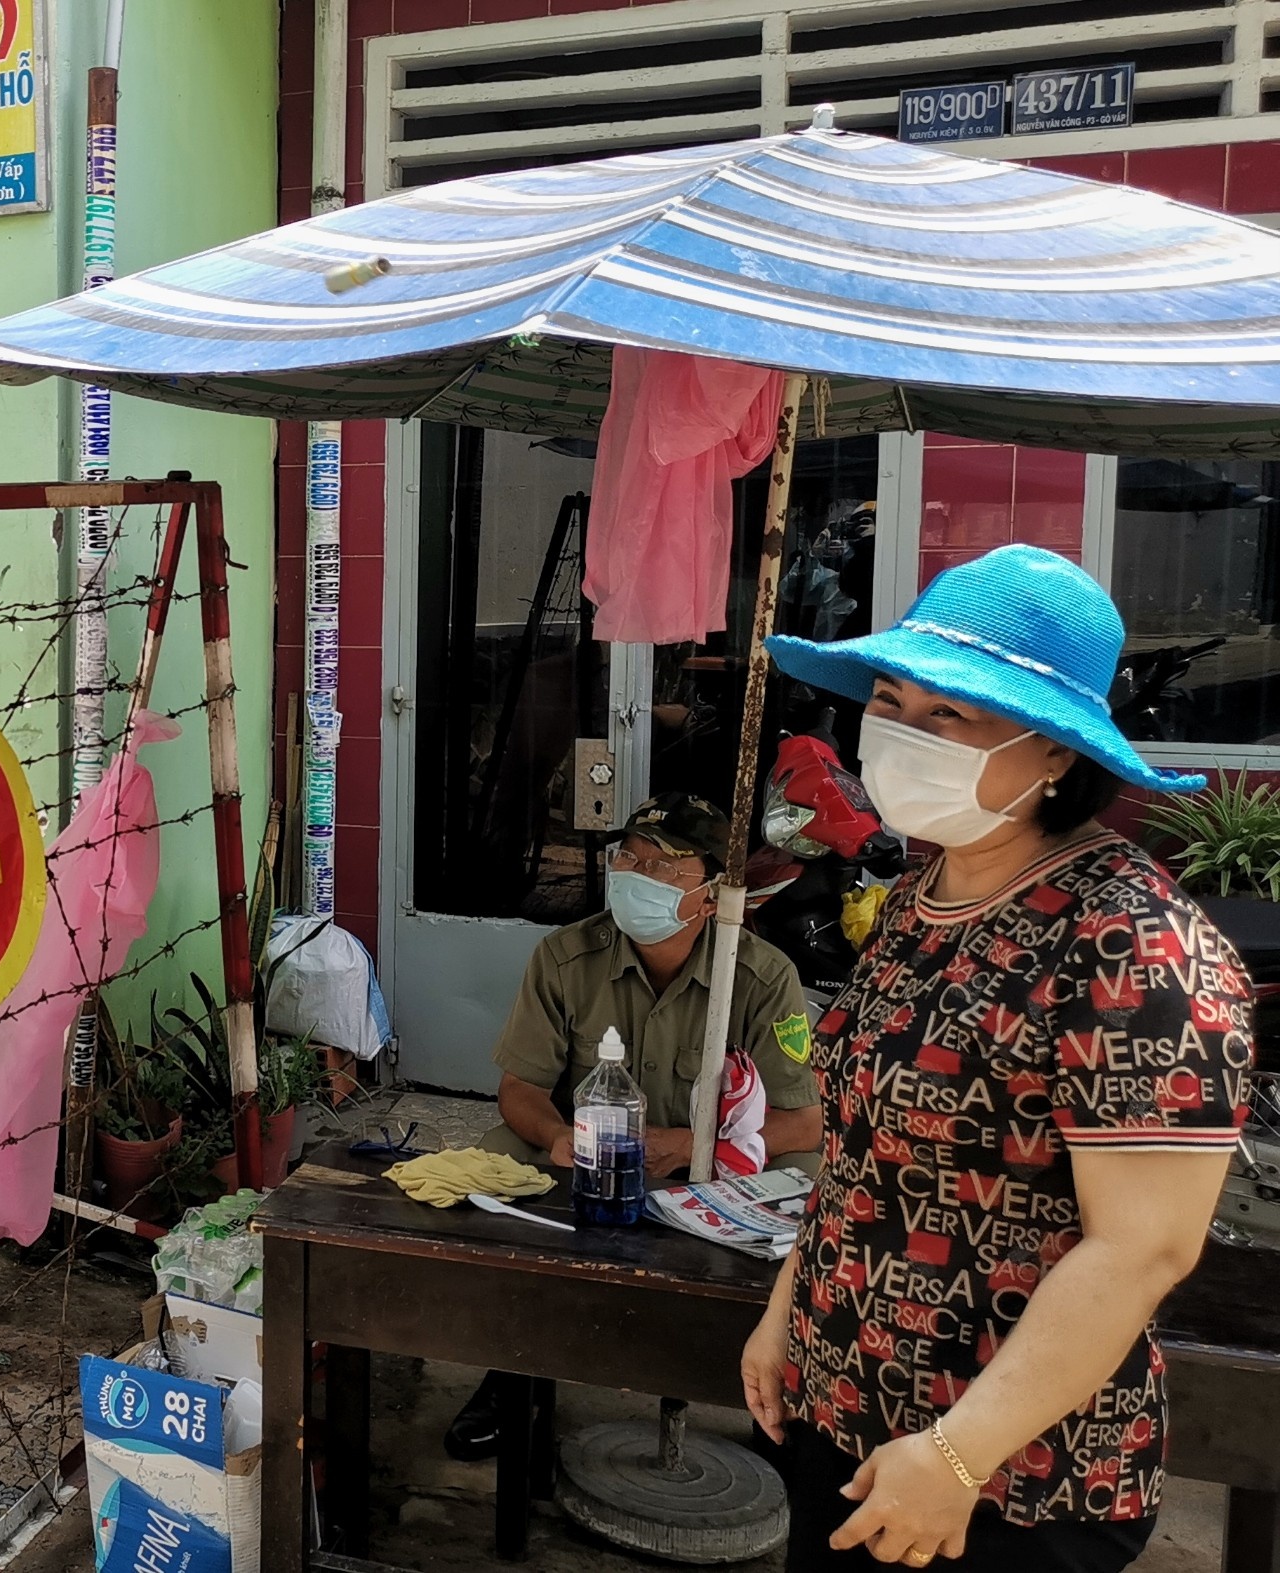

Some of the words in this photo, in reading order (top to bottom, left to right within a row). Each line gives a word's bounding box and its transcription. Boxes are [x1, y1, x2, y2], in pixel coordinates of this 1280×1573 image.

[1018, 70, 1127, 115] 437/11
[815, 979, 846, 989] HON
[1070, 1065, 1215, 1111] VERSACE
[861, 1090, 997, 1149] VERSACE
[875, 1124, 954, 1167] SACE
[849, 1284, 974, 1345] VERSACE
[862, 1318, 934, 1367] SACE
[97, 1374, 114, 1419] THÙNG
[121, 1386, 136, 1421] MỚI
[162, 1390, 190, 1440] 28
[191, 1396, 207, 1443] CHAI
[1060, 1411, 1158, 1453] VERSACE
[1072, 1447, 1135, 1478] SACE
[133, 1507, 192, 1573] AFINA
